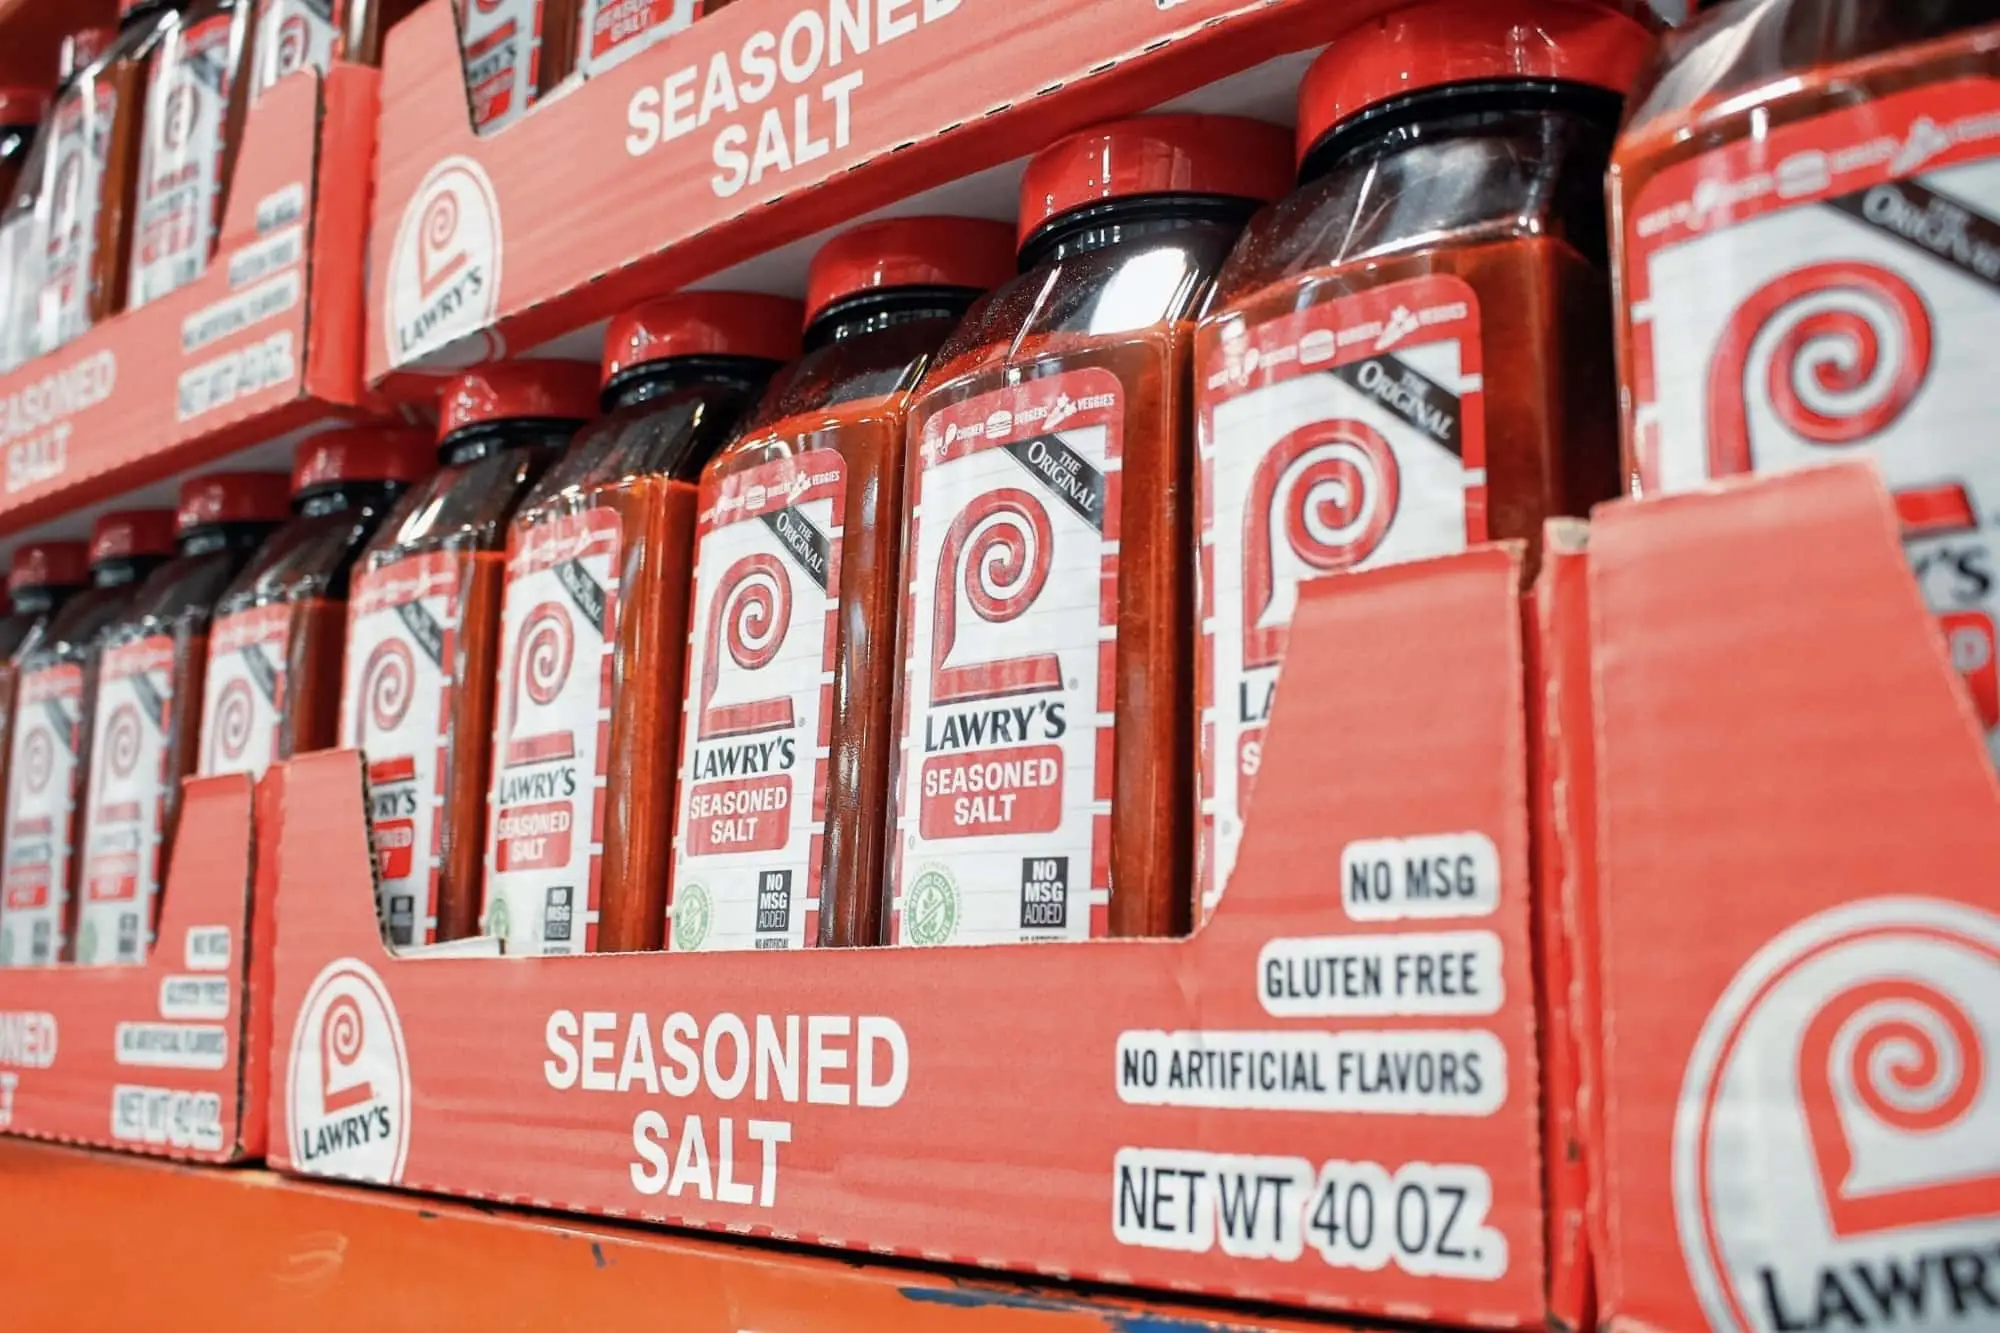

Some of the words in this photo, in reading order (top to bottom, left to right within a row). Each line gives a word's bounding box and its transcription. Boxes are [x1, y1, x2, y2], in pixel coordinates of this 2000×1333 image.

[711, 70, 863, 197] SALT
[401, 266, 482, 352] LAWRY'S
[1077, 393, 1116, 411] VEGGIES
[1358, 360, 1454, 439] ORIGINAL
[1028, 441, 1096, 512] ORIGINAL
[1060, 451, 1082, 474] THE
[777, 512, 824, 573] ORIGINAL
[798, 522, 813, 542] THE
[925, 699, 1066, 752] LAWRY'S
[693, 735, 795, 780] LAWRY'S
[500, 768, 576, 804] LAWRY'S
[924, 757, 1058, 798] SEASONED
[690, 786, 787, 819] SEASONED
[953, 794, 1017, 826] SALT
[498, 810, 571, 835] SEASONED
[710, 817, 758, 844] SALT
[511, 838, 547, 862] SALT
[766, 873, 783, 891] NO
[1032, 859, 1057, 881] NO
[1349, 860, 1391, 904] NO
[1405, 856, 1476, 898] MSG
[551, 889, 567, 905] NO
[760, 892, 788, 910] MSG
[1025, 881, 1064, 903] MSG
[547, 905, 571, 921] MSG
[759, 910, 785, 928] ADDED
[1024, 903, 1062, 924] ADDED
[1265, 956, 1382, 999] GLUTEN
[1394, 952, 1479, 995] FREE
[544, 1009, 909, 1108] SEASONED
[1123, 1048, 1157, 1088] NO
[1168, 1050, 1326, 1092] ARTIFICIAL
[1338, 1052, 1482, 1096] FLAVORS
[304, 1105, 390, 1160] LAWRY'S
[629, 1110, 792, 1208] SALT
[1120, 1165, 1206, 1234] NET
[1217, 1174, 1295, 1243] WT
[1311, 1181, 1374, 1251] 40
[1395, 1184, 1484, 1260] OZ.
